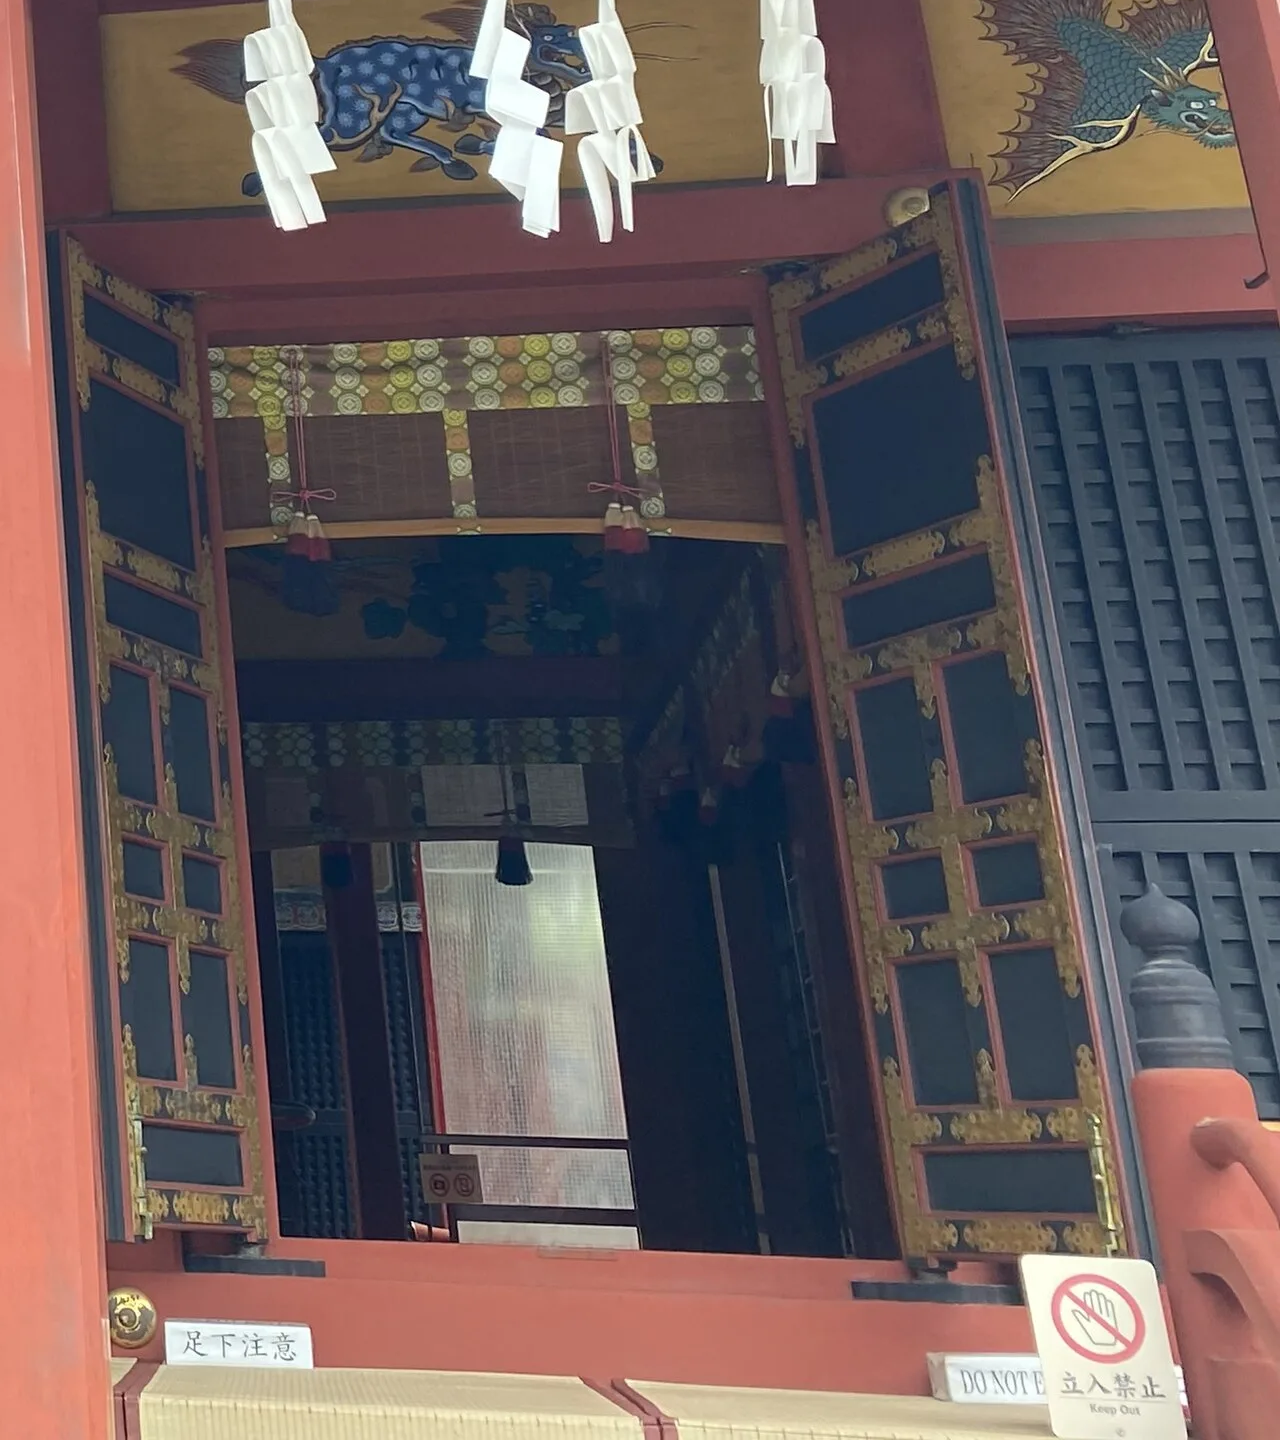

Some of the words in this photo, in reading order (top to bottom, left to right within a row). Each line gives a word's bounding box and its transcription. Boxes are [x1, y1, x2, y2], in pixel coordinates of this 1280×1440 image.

[182, 1329, 298, 1362] 足下注意
[959, 1368, 988, 1396] DO
[992, 1369, 1030, 1396] NOT
[1060, 1371, 1167, 1399] 立入禁止
[1088, 1403, 1118, 1416] Keep
[1119, 1405, 1142, 1417] Out
